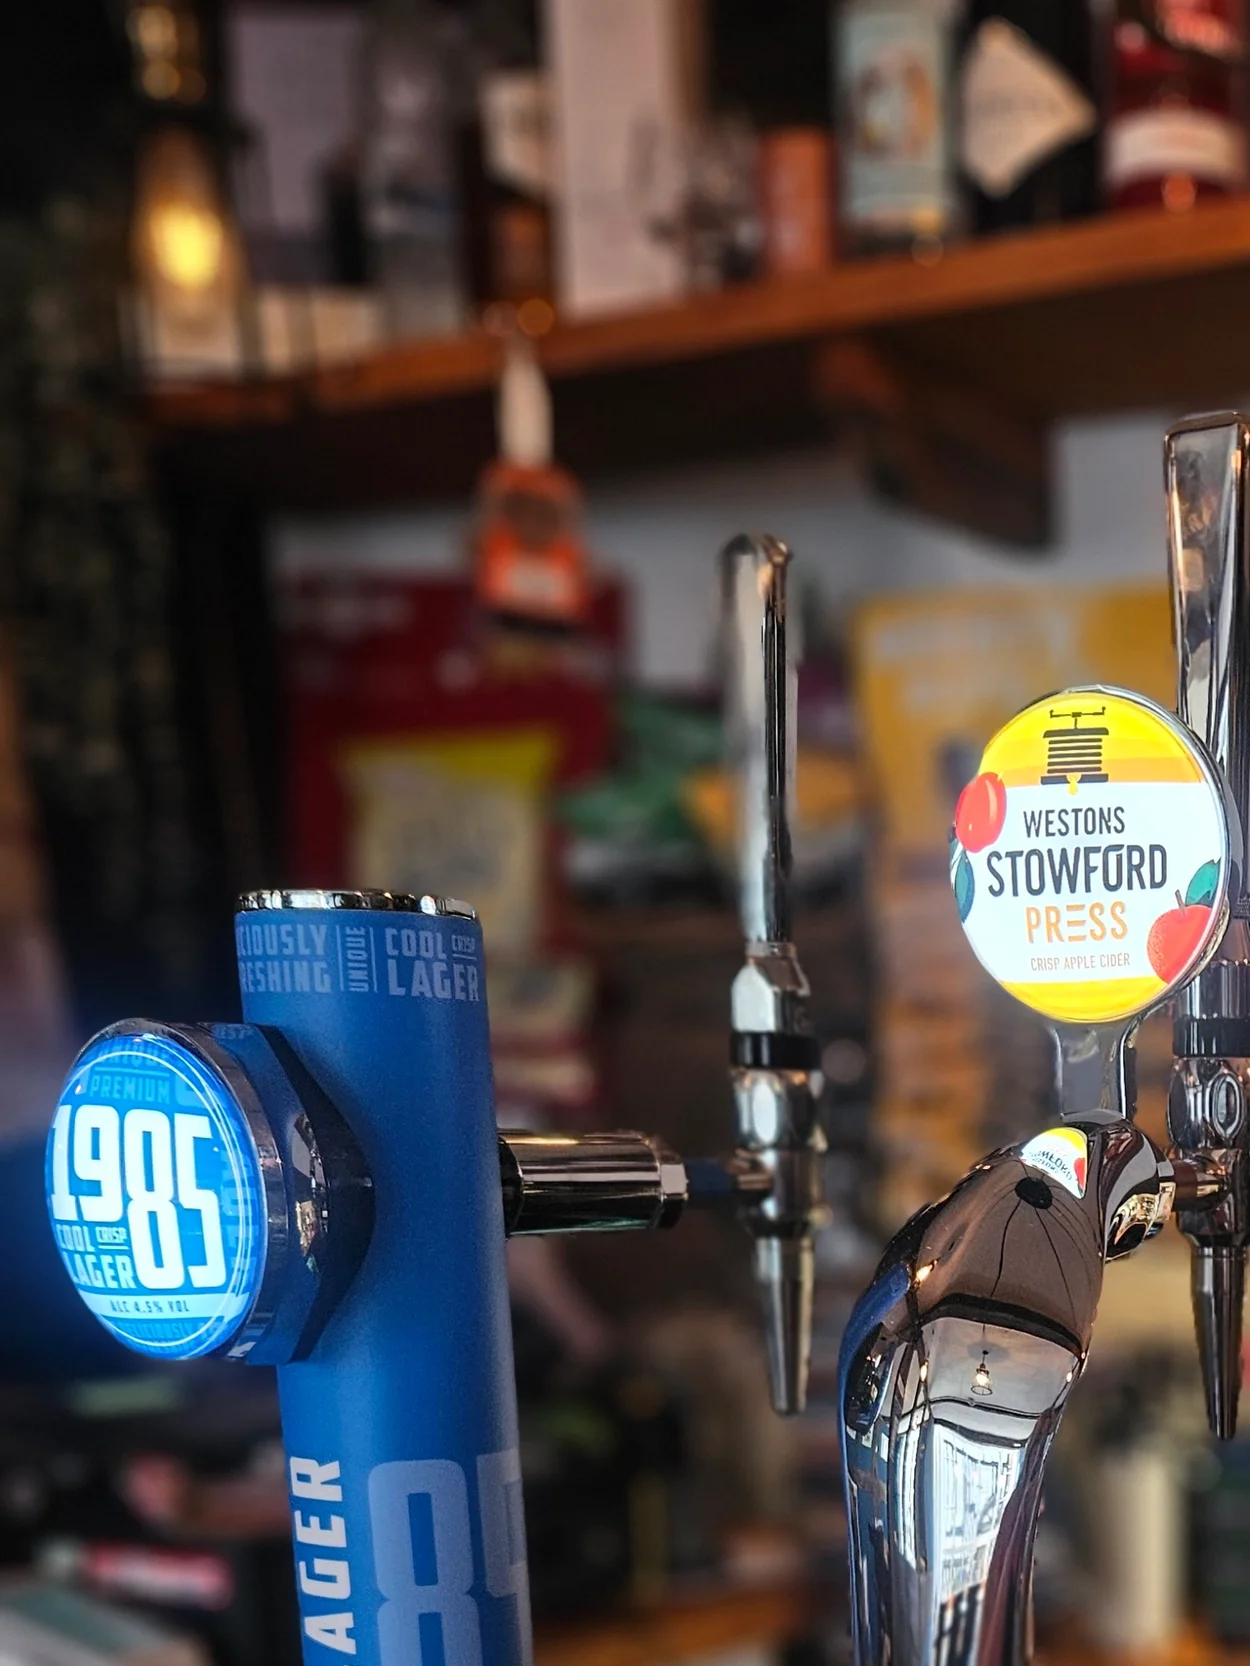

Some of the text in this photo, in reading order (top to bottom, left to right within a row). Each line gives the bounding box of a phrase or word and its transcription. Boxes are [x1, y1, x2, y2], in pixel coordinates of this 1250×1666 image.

[1023, 807, 1125, 838] WESTONS
[986, 844, 1167, 897] STOWFORD
[1026, 901, 1128, 944] PRESS
[345, 926, 369, 992] UNIQUE
[385, 927, 447, 960] COOL
[1030, 952, 1130, 971] CRISP APPLE CIDER
[388, 960, 479, 1002] LAGER
[90, 1074, 170, 1104] PREMIUM
[51, 1104, 227, 1290] 1985
[56, 1224, 95, 1253] COOL
[61, 1250, 137, 1289] LAGER
[110, 1300, 130, 1313] ALC
[167, 1299, 190, 1312] VOL
